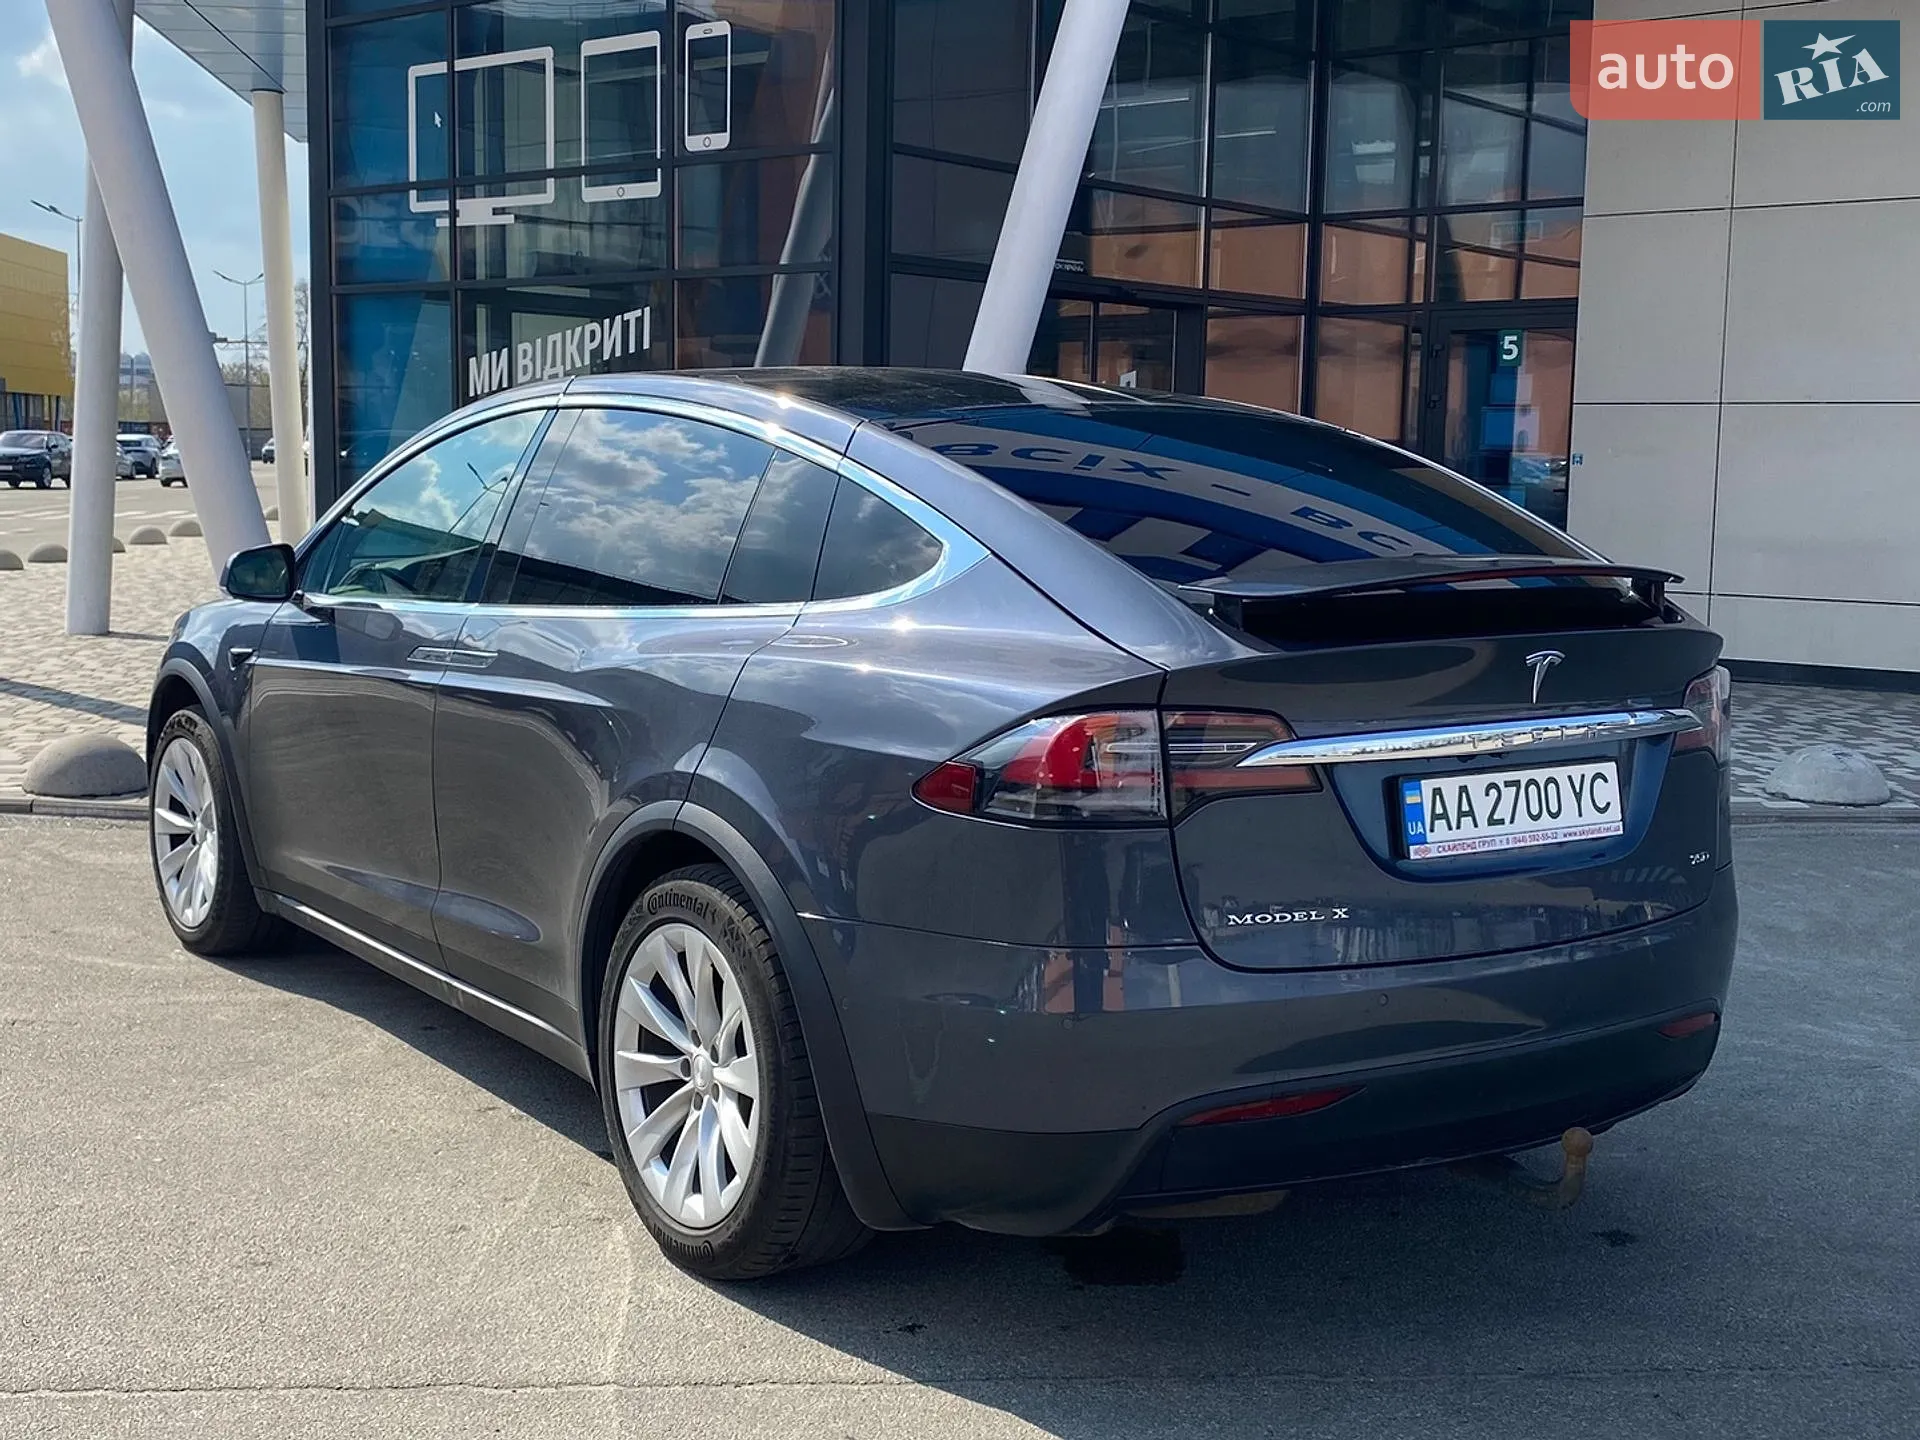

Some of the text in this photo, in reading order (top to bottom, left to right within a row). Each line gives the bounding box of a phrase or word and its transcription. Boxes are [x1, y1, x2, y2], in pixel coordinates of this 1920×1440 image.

[469, 306, 650, 397] МИ ВІДКРИТІ
[1501, 335, 1518, 360] 5
[1429, 772, 1611, 833] AA 2700 YC
[1408, 821, 1424, 835] UA
[647, 888, 710, 919] Continental
[1227, 907, 1350, 926] MODEL X
